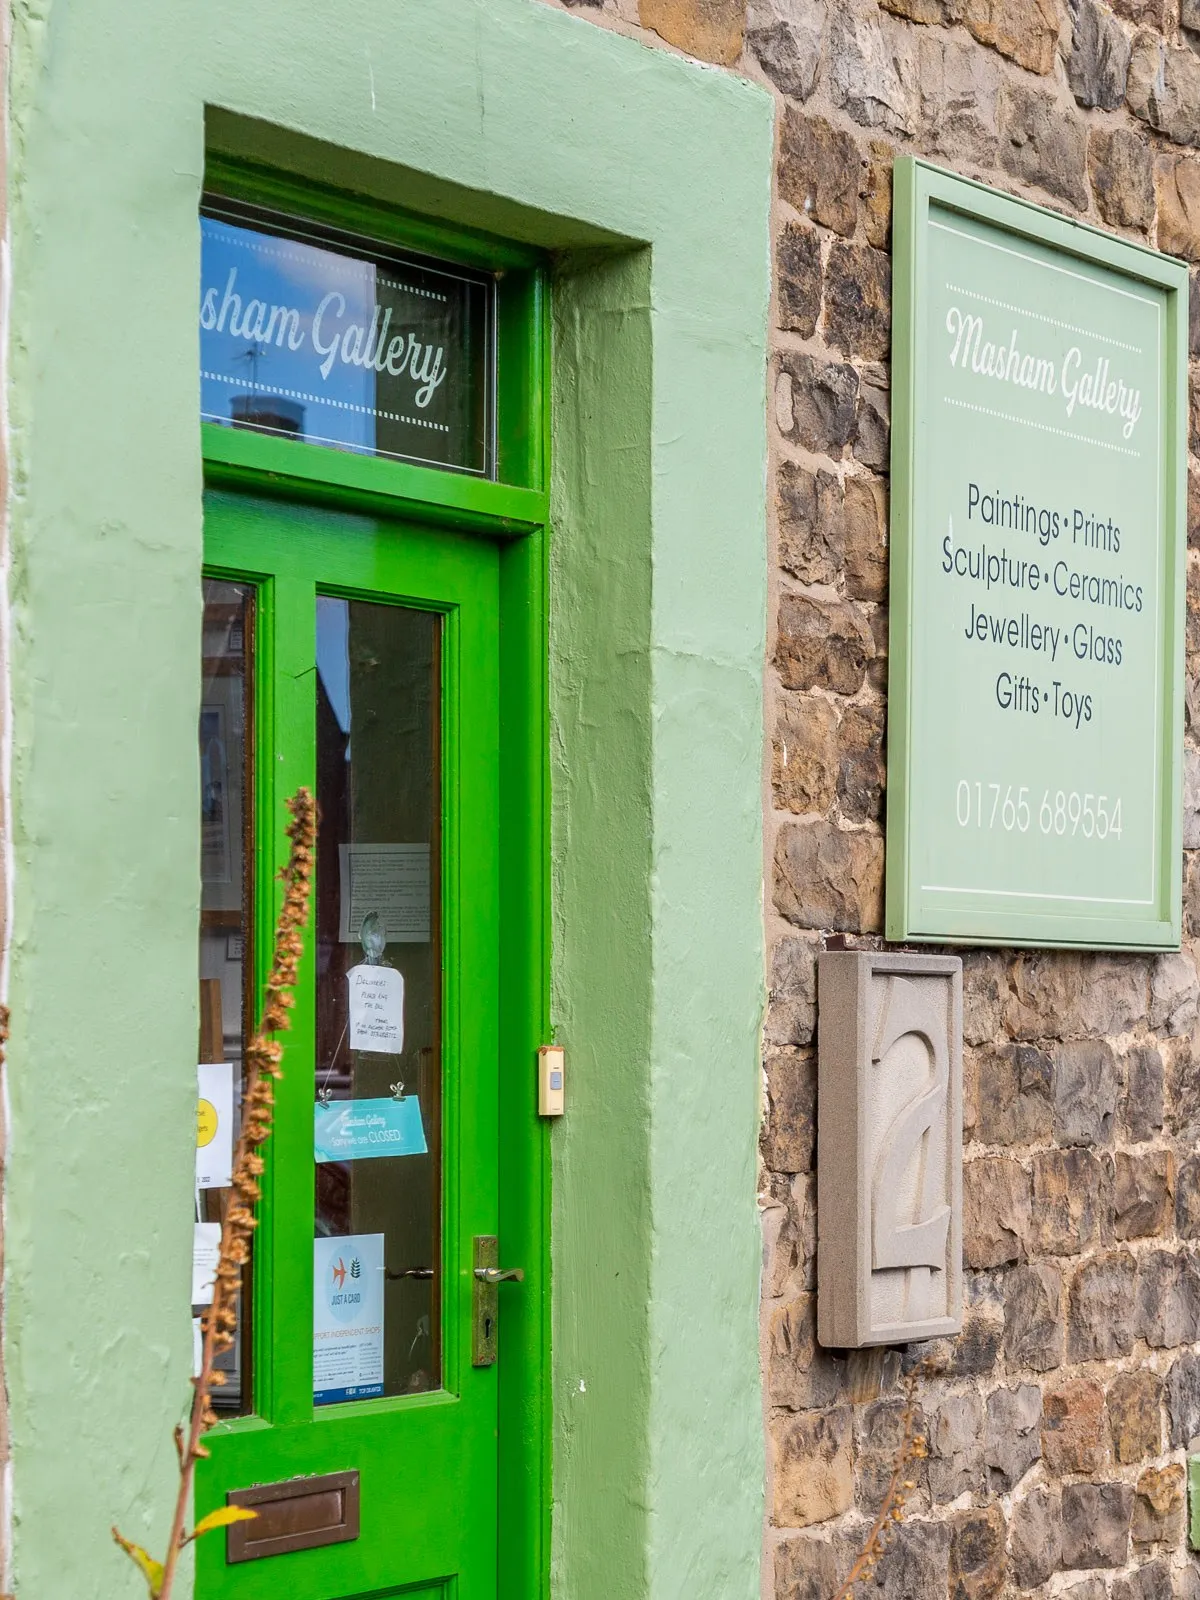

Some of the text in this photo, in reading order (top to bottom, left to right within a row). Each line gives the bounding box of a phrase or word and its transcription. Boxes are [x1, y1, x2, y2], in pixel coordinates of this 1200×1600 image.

[312, 291, 447, 408] Gallery
[946, 307, 1142, 439] Masham Gallery
[968, 483, 1120, 553] Paintings Prints
[942, 536, 1143, 612] Sculpture Ceramics
[965, 604, 1122, 665] Jewellery Glass
[996, 672, 1092, 729] Gifts Toys
[956, 780, 1123, 841] 01765 689554
